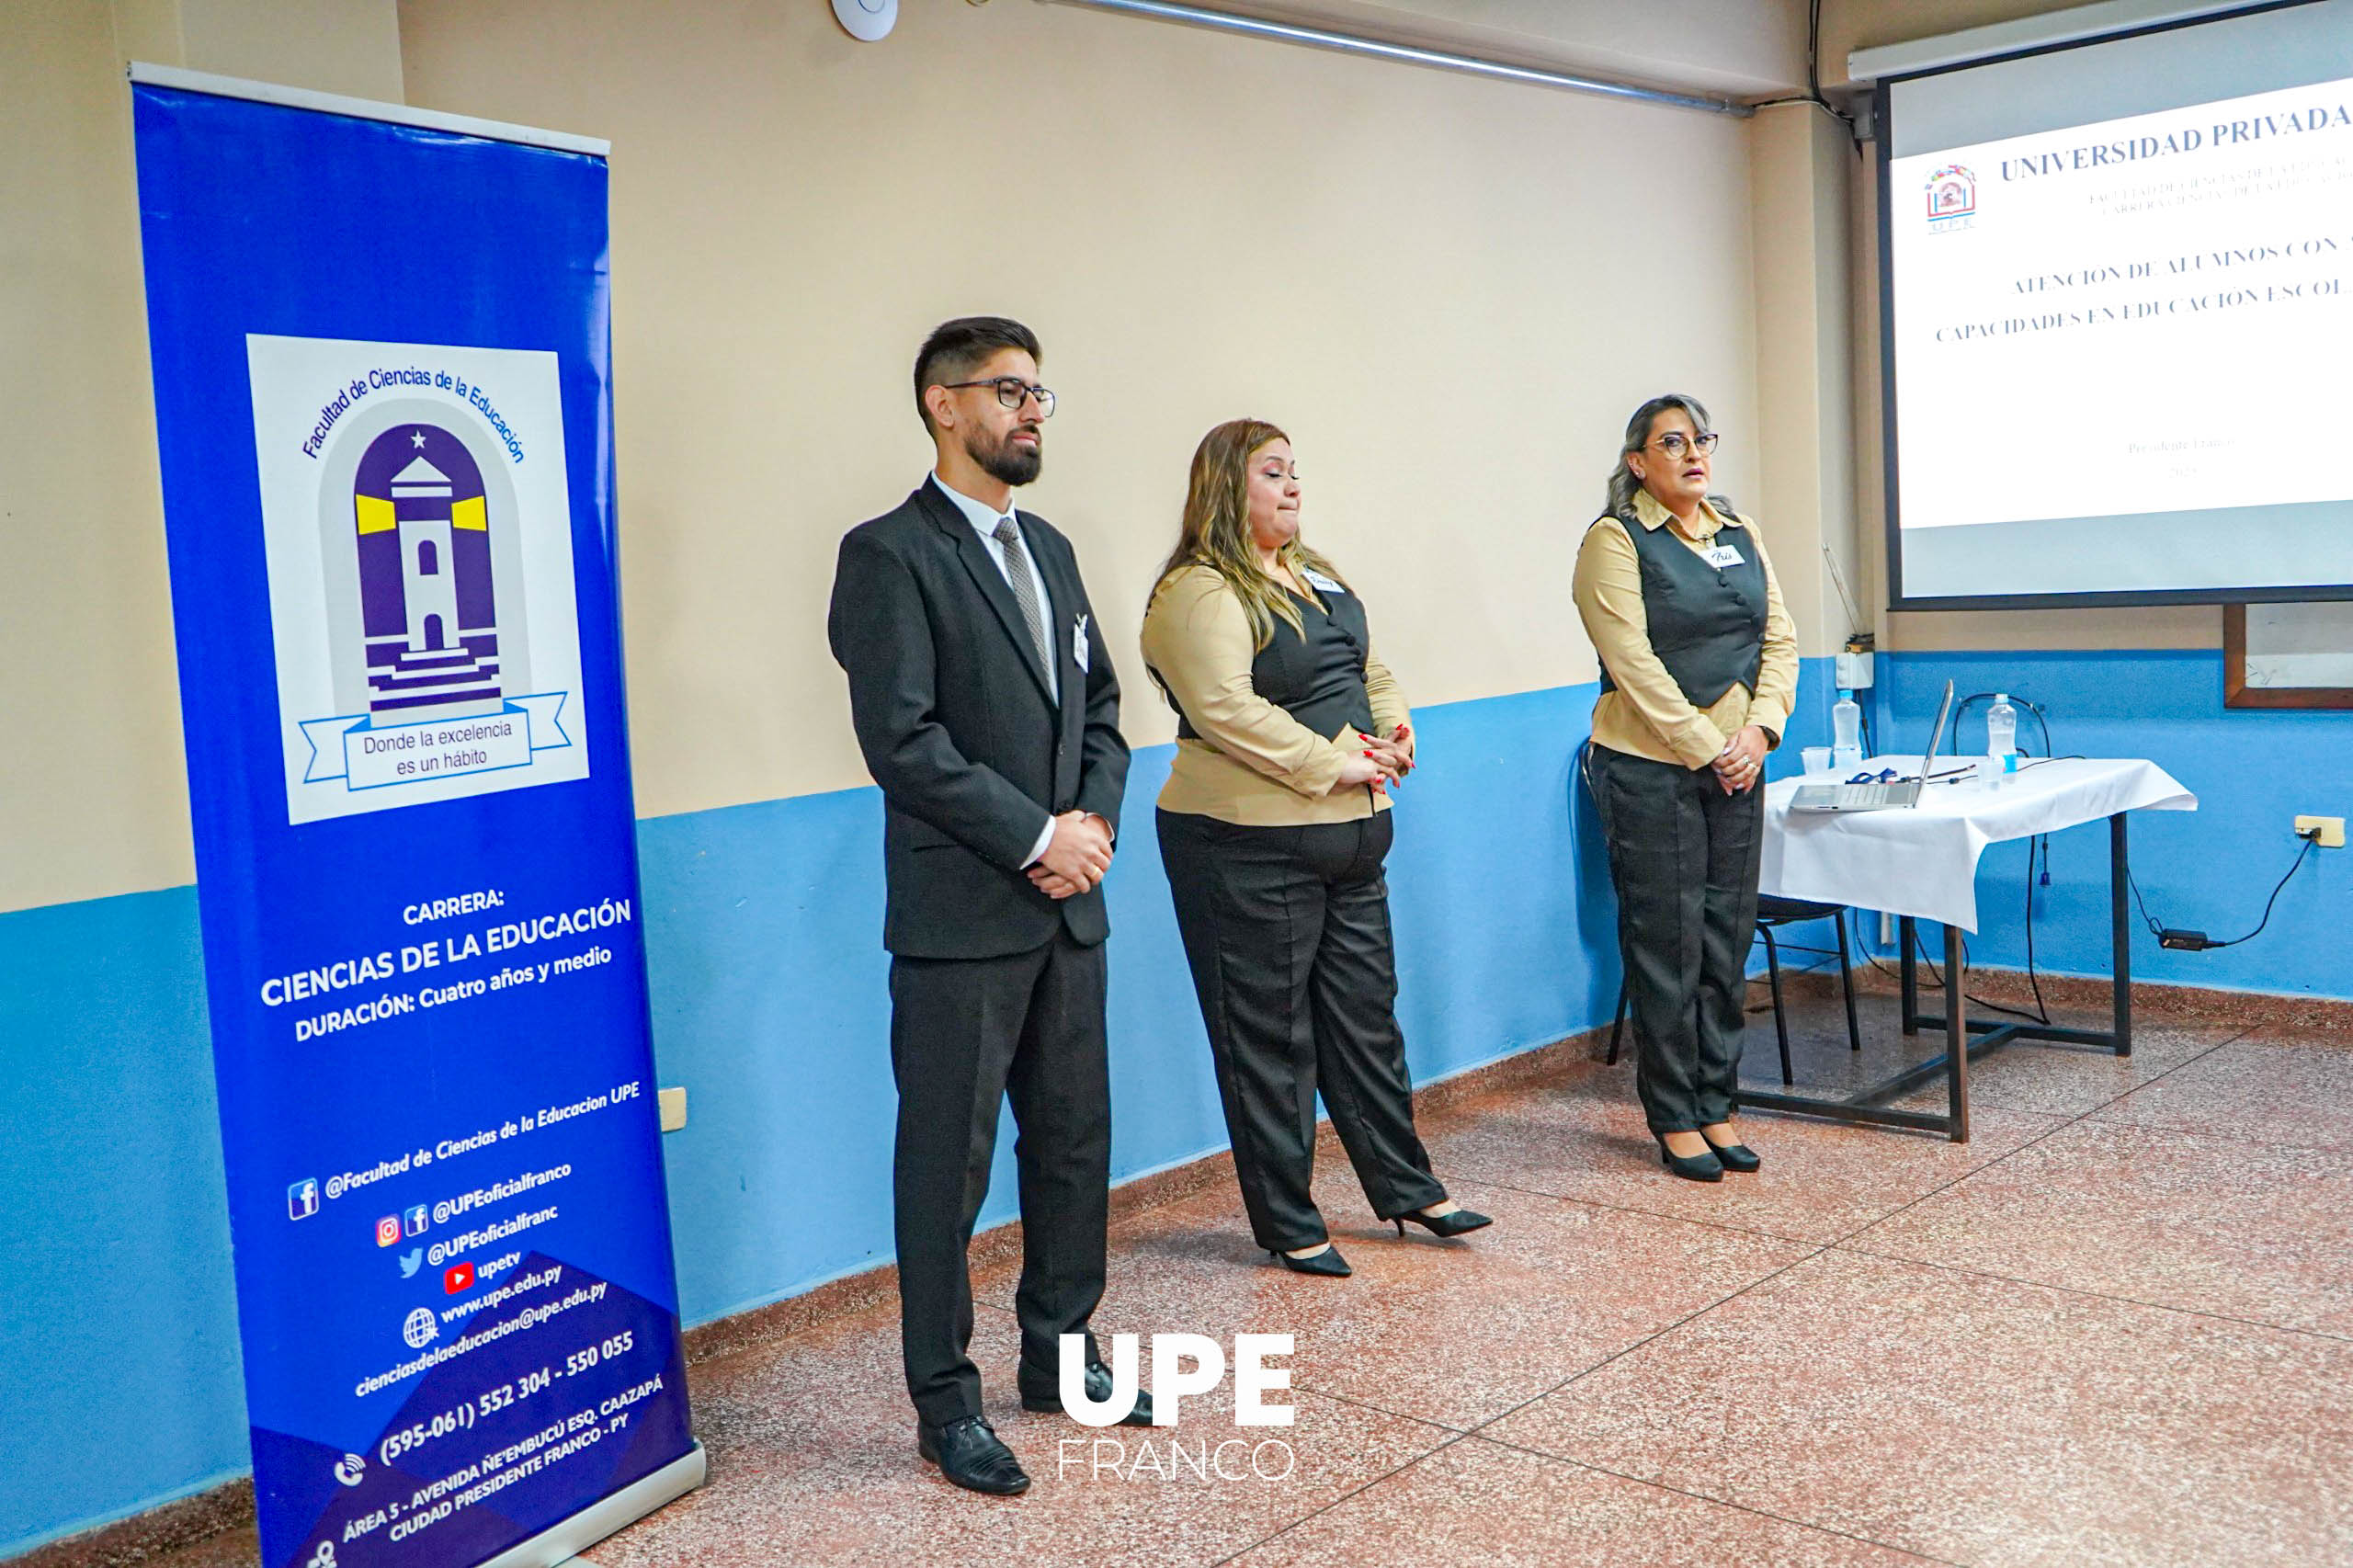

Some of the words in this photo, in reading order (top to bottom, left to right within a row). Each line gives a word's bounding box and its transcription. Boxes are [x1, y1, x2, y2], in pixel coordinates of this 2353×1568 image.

[2001, 129, 2202, 182] UNIVERSIDAD
[2212, 104, 2351, 146] PRIVADA
[2130, 262, 2155, 279] DE
[2168, 245, 2278, 274] ALUMNOS
[2285, 236, 2337, 257] CON
[1936, 312, 2081, 342] CAPACIDADES
[2088, 307, 2115, 324] EN
[302, 390, 351, 459] Facultad
[350, 381, 368, 399] de
[369, 365, 431, 390] Ciencias
[435, 369, 452, 390] de
[456, 377, 466, 397] la
[469, 387, 524, 463] Educación
[364, 732, 415, 755] Donde
[420, 730, 433, 747] la
[438, 722, 512, 744] excelencia
[397, 759, 415, 775] es
[421, 756, 438, 772] un
[444, 747, 487, 769] hábito
[403, 889, 505, 926] CARRERA:
[260, 951, 394, 1006] CIENCIAS
[401, 941, 440, 973] DE
[447, 933, 482, 962] LA
[486, 898, 631, 954] EDUCACIÓN
[295, 994, 415, 1041] DURACIÓN:
[419, 978, 486, 1007] Cuatro
[490, 963, 534, 992] años
[537, 961, 550, 983] y
[553, 945, 612, 975] medio
[325, 1153, 410, 1199] @Facultad
[414, 1148, 432, 1170] de
[436, 1131, 497, 1161] Ciencias
[500, 1120, 517, 1140] de
[521, 1115, 534, 1133] la
[538, 1095, 608, 1128] Educacion
[610, 1082, 640, 1104] UPE
[432, 1162, 572, 1224] @UPEoficialfranco
[427, 1205, 558, 1266] @UPEoficialfranc
[477, 1250, 521, 1279] upetv
[440, 1264, 563, 1324] www.upe.edu.py
[356, 1282, 607, 1398] cienciasdelaeducacion@upe.edu.py
[381, 1403, 475, 1466] (595-061)
[480, 1386, 514, 1417] 552
[518, 1368, 551, 1399] 304
[567, 1348, 597, 1378] 550
[602, 1331, 634, 1361] 055
[343, 1508, 387, 1544] ÁREA
[390, 1499, 399, 1518] 5
[411, 1466, 480, 1510] AVENIDA
[567, 1408, 598, 1433] ESQ.
[600, 1374, 663, 1416] CAAZAPÁ
[390, 1504, 452, 1542] CIUDAD
[455, 1460, 541, 1511] PRESIDENTE
[545, 1428, 601, 1467] FRANCO
[611, 1413, 629, 1437] PY
